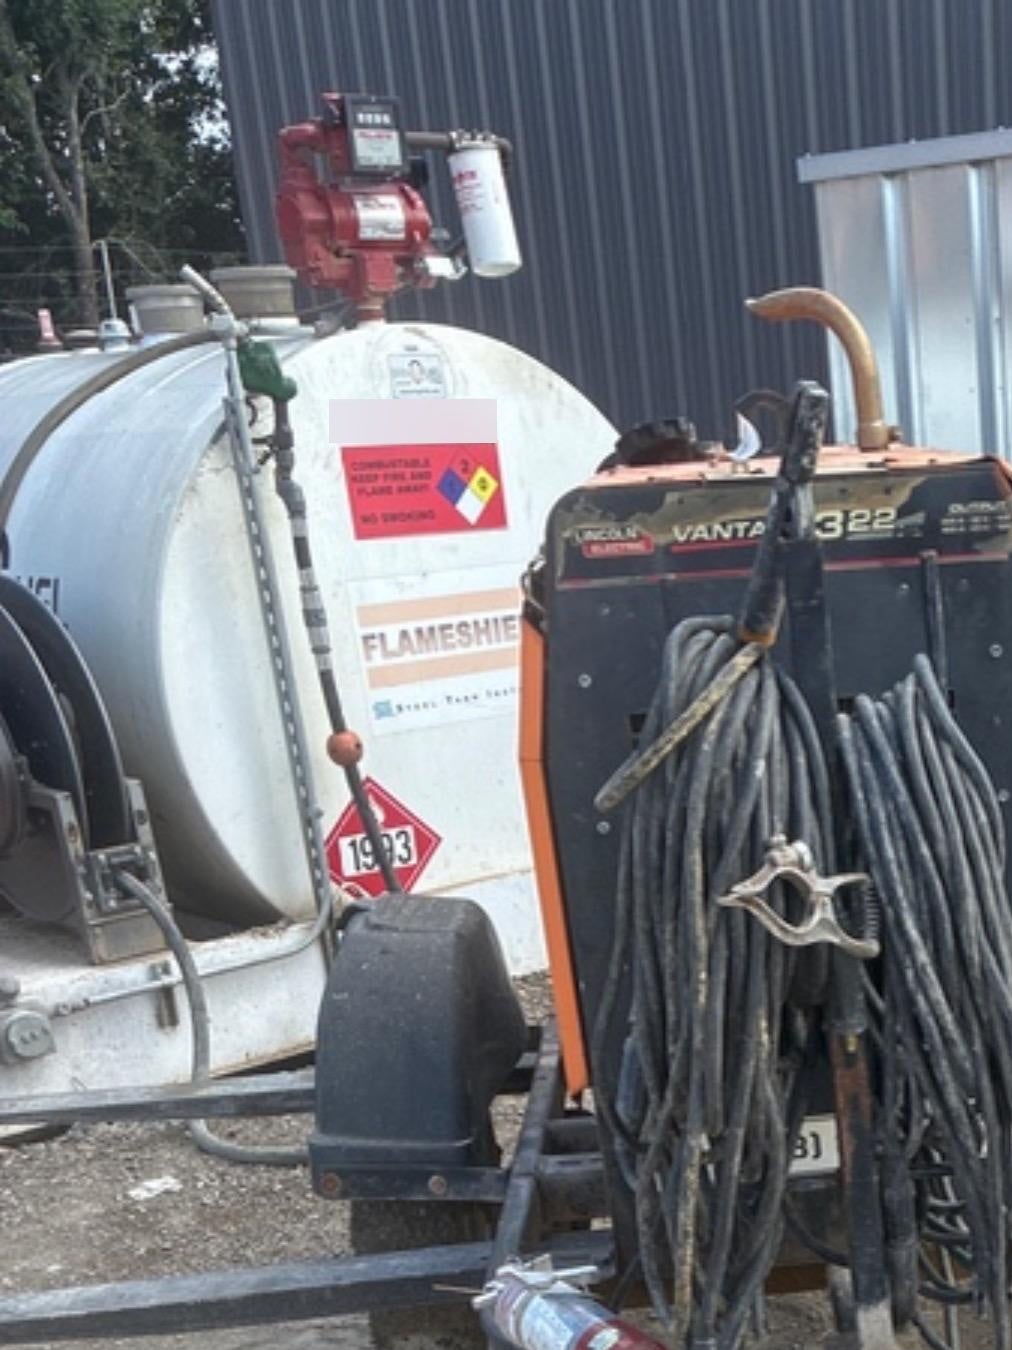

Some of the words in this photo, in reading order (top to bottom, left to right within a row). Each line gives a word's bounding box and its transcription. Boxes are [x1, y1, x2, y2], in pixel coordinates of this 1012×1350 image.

[459, 458, 470, 475] 2
[410, 470, 432, 481] AND
[361, 514, 378, 524] NO
[382, 509, 436, 523] SMOKING
[672, 519, 767, 543] VANTA
[814, 508, 896, 540] 322
[361, 614, 518, 662] FLAMESHIE
